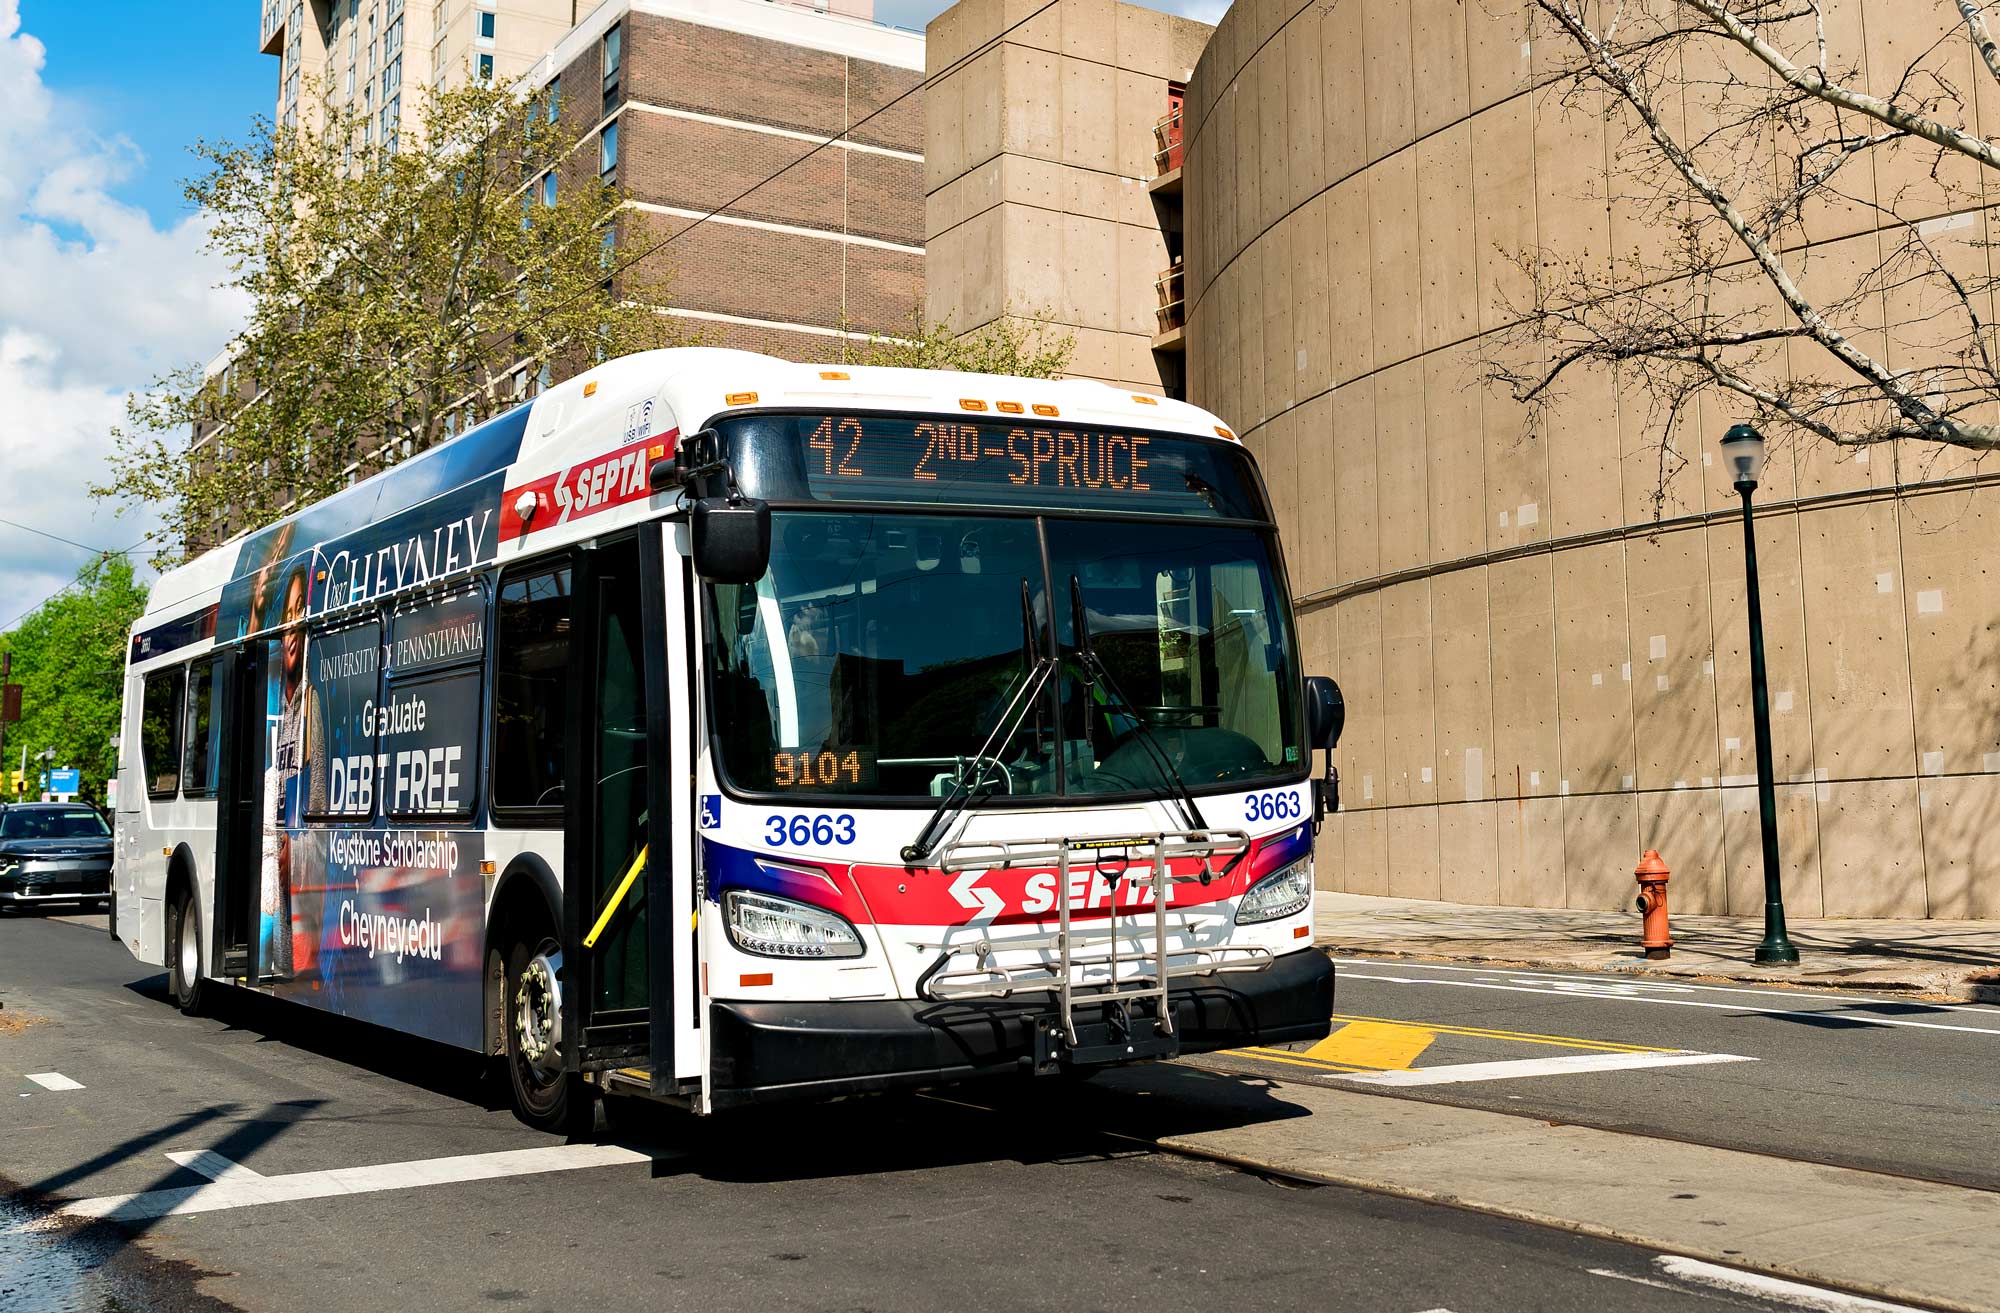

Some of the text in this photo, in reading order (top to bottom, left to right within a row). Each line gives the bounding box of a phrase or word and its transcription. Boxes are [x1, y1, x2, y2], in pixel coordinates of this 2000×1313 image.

[623, 428, 636, 443] USB
[809, 416, 862, 476] 42
[575, 448, 647, 512] SEPTA
[323, 508, 493, 632] CHEYNEY
[319, 646, 376, 682] UNIVERSITY
[397, 620, 483, 667] PENNSYLVANIA
[362, 693, 426, 738] Graduate
[328, 753, 390, 816] DEBT
[393, 745, 462, 816] FREE
[774, 751, 860, 786] 9104
[764, 814, 856, 847] 3663
[1244, 790, 1301, 822] 3663
[329, 831, 458, 878] Keystone Scholarship
[1021, 864, 1175, 915] SEPTA
[340, 900, 442, 964] Cheyney.edu
